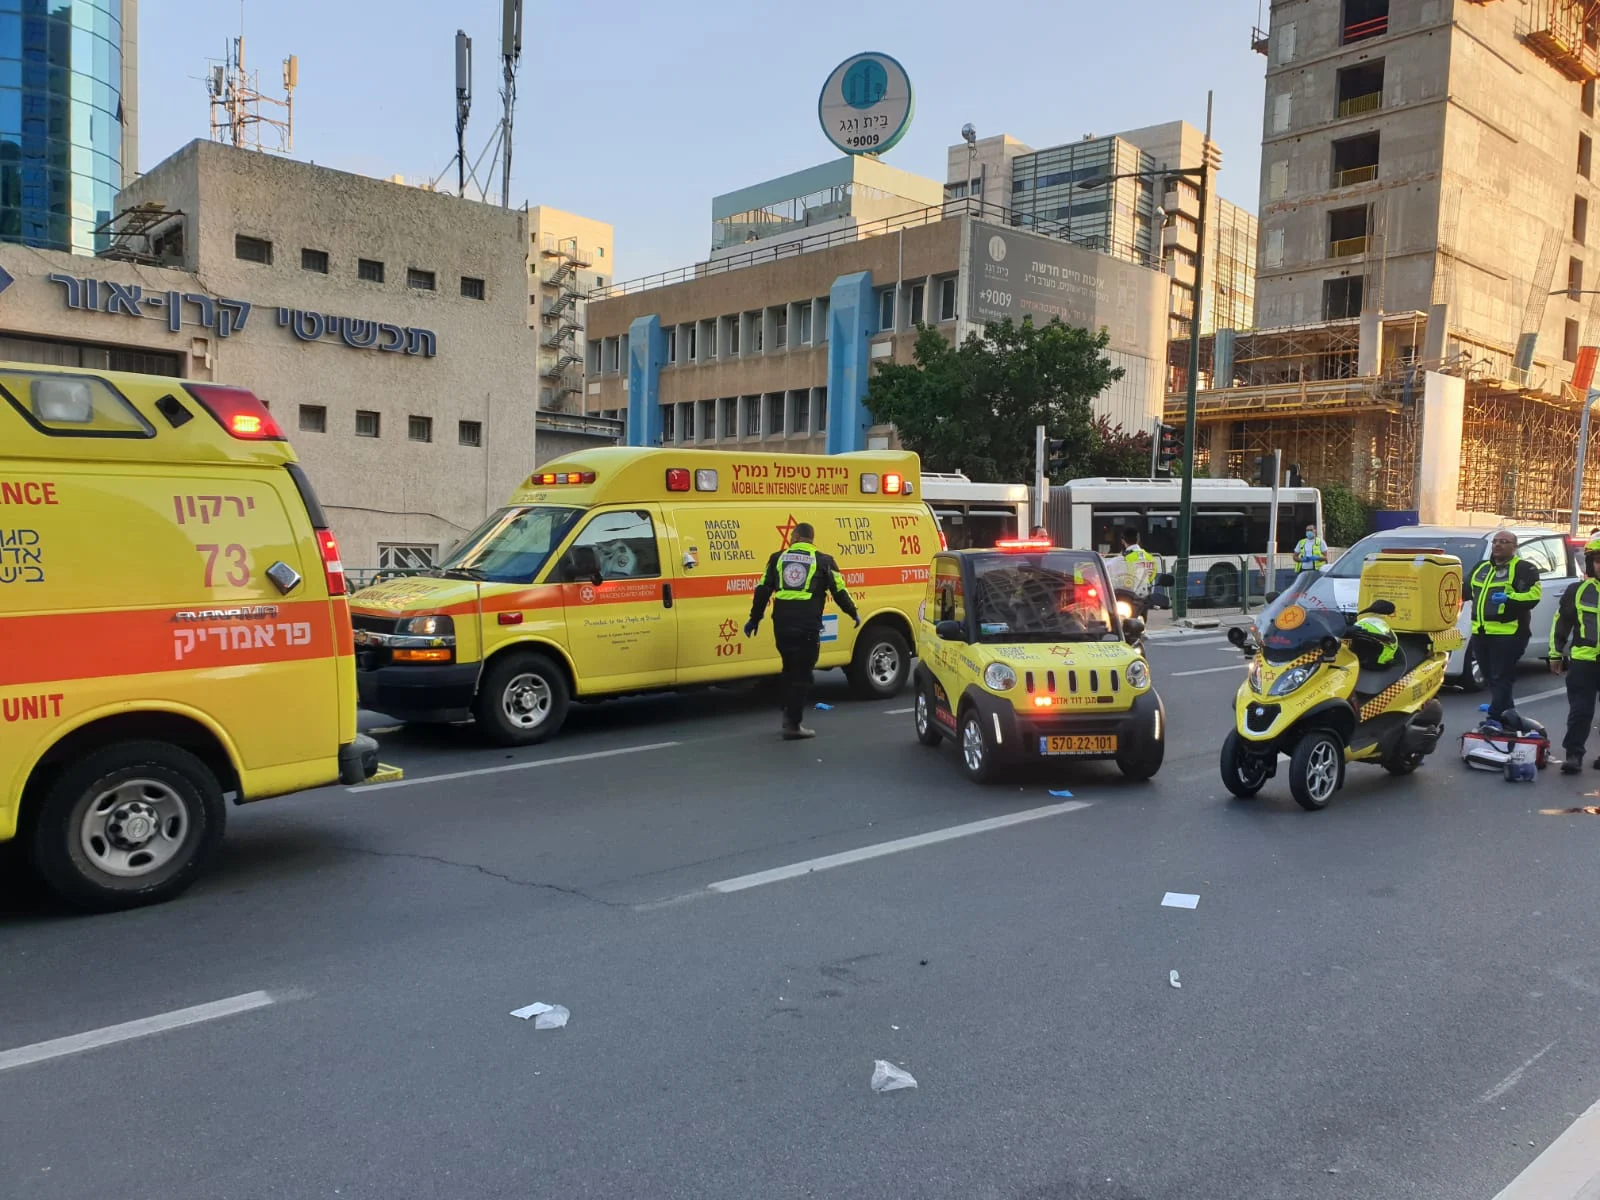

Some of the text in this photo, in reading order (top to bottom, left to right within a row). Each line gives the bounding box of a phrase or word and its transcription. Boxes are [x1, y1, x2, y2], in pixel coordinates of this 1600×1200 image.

[1032, 261, 1059, 277] חדשה
[1062, 268, 1081, 282] חיים
[50, 273, 437, 357] תכשיטי קרן-אור
[732, 462, 849, 480] ניידת טיפול נמרץ
[0, 482, 59, 505] NCE
[732, 481, 849, 495] MOBILE INTENSIVE CARE UNIT
[173, 494, 255, 525] ירקון
[704, 519, 740, 530] MAGEN
[835, 517, 870, 530] מגן דוד
[891, 515, 919, 529] ירקון
[706, 530, 737, 541] DAVID
[849, 530, 873, 542] אדום
[709, 540, 739, 551] ADOM
[837, 542, 875, 556] בישראל
[899, 534, 921, 555] 218
[0, 547, 42, 565] אדו
[710, 550, 756, 561] IN ISRAEL
[195, 543, 251, 588] 73
[0, 566, 45, 584] ביש
[847, 572, 865, 585] ADOM
[901, 568, 930, 583] אמדיק
[726, 577, 760, 593] AMERICA
[173, 621, 311, 661] פראמדיק
[715, 643, 742, 657] 101
[1070, 696, 1082, 704] דוד
[2, 693, 64, 722] UNIT
[1051, 736, 1112, 750] 570-22-101
